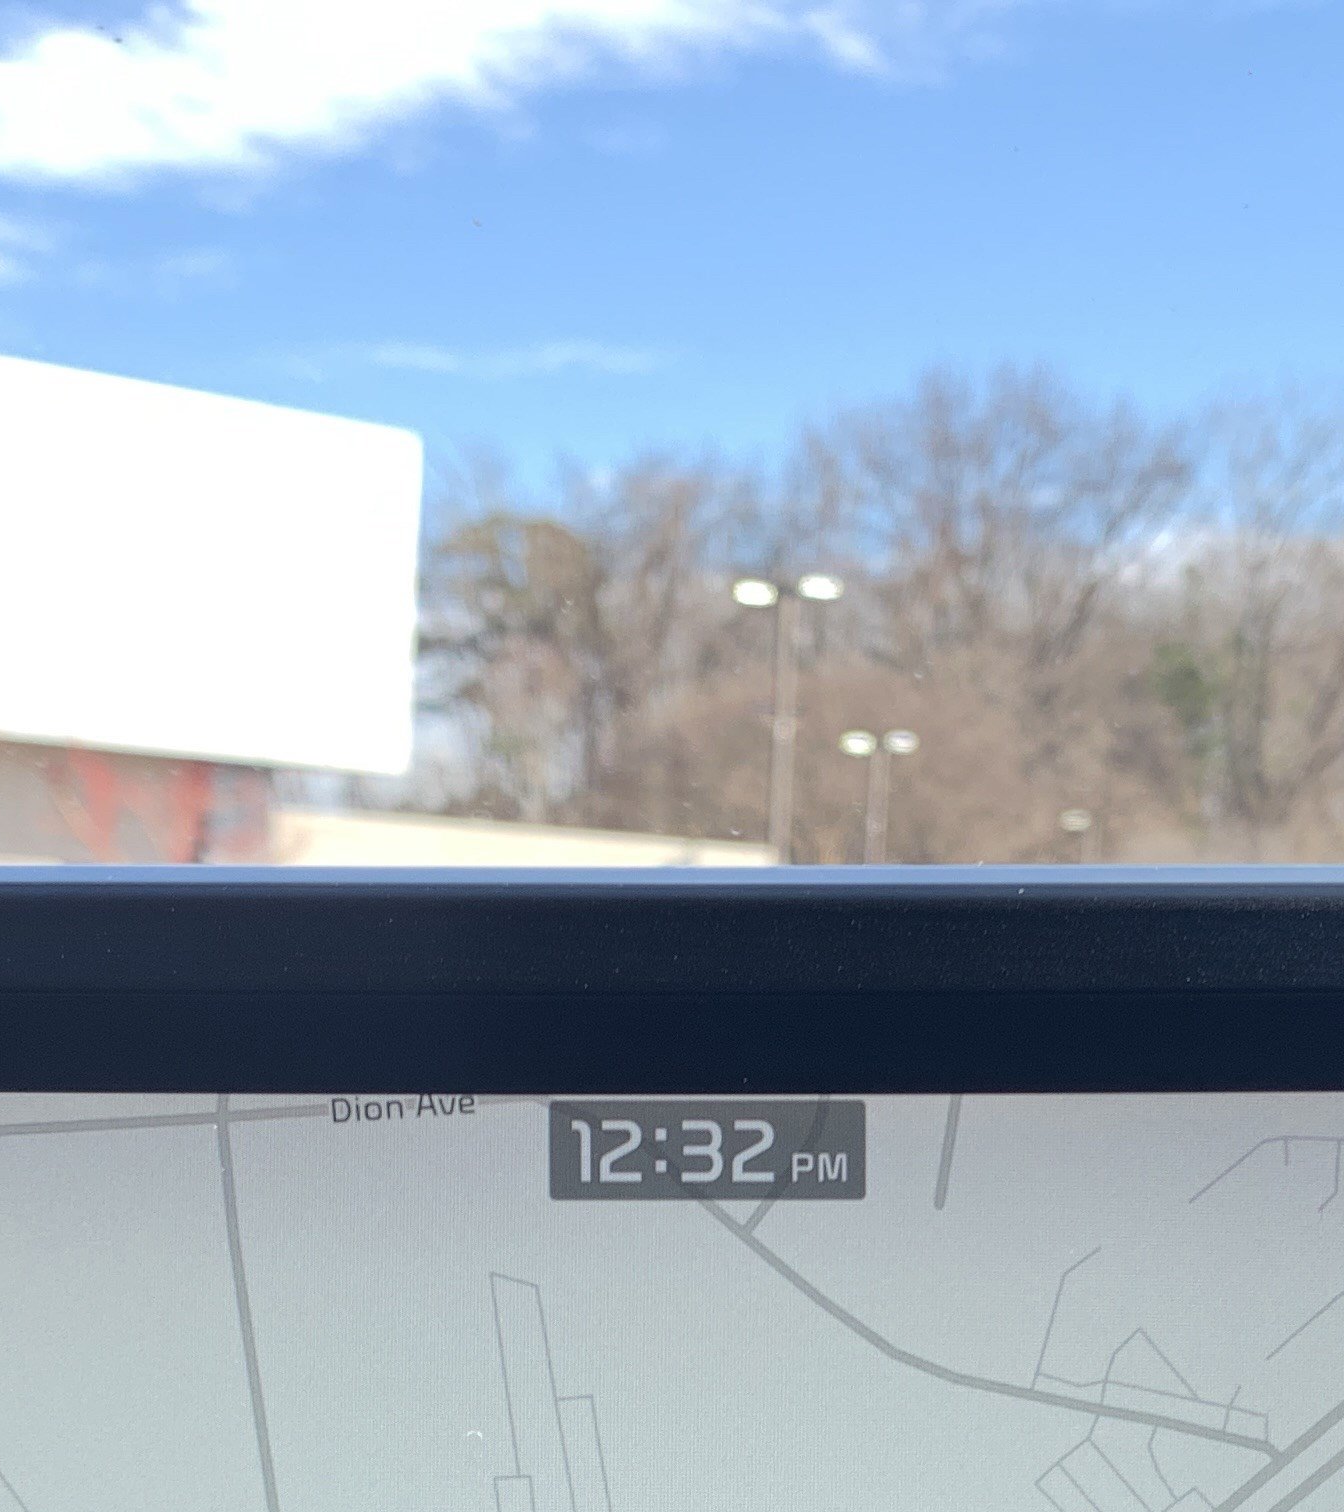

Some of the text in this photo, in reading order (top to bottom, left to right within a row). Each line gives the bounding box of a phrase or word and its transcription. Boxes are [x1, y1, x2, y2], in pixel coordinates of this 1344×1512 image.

[331, 1092, 476, 1124] Dion Ave
[571, 1118, 848, 1184] 12:32 PM
